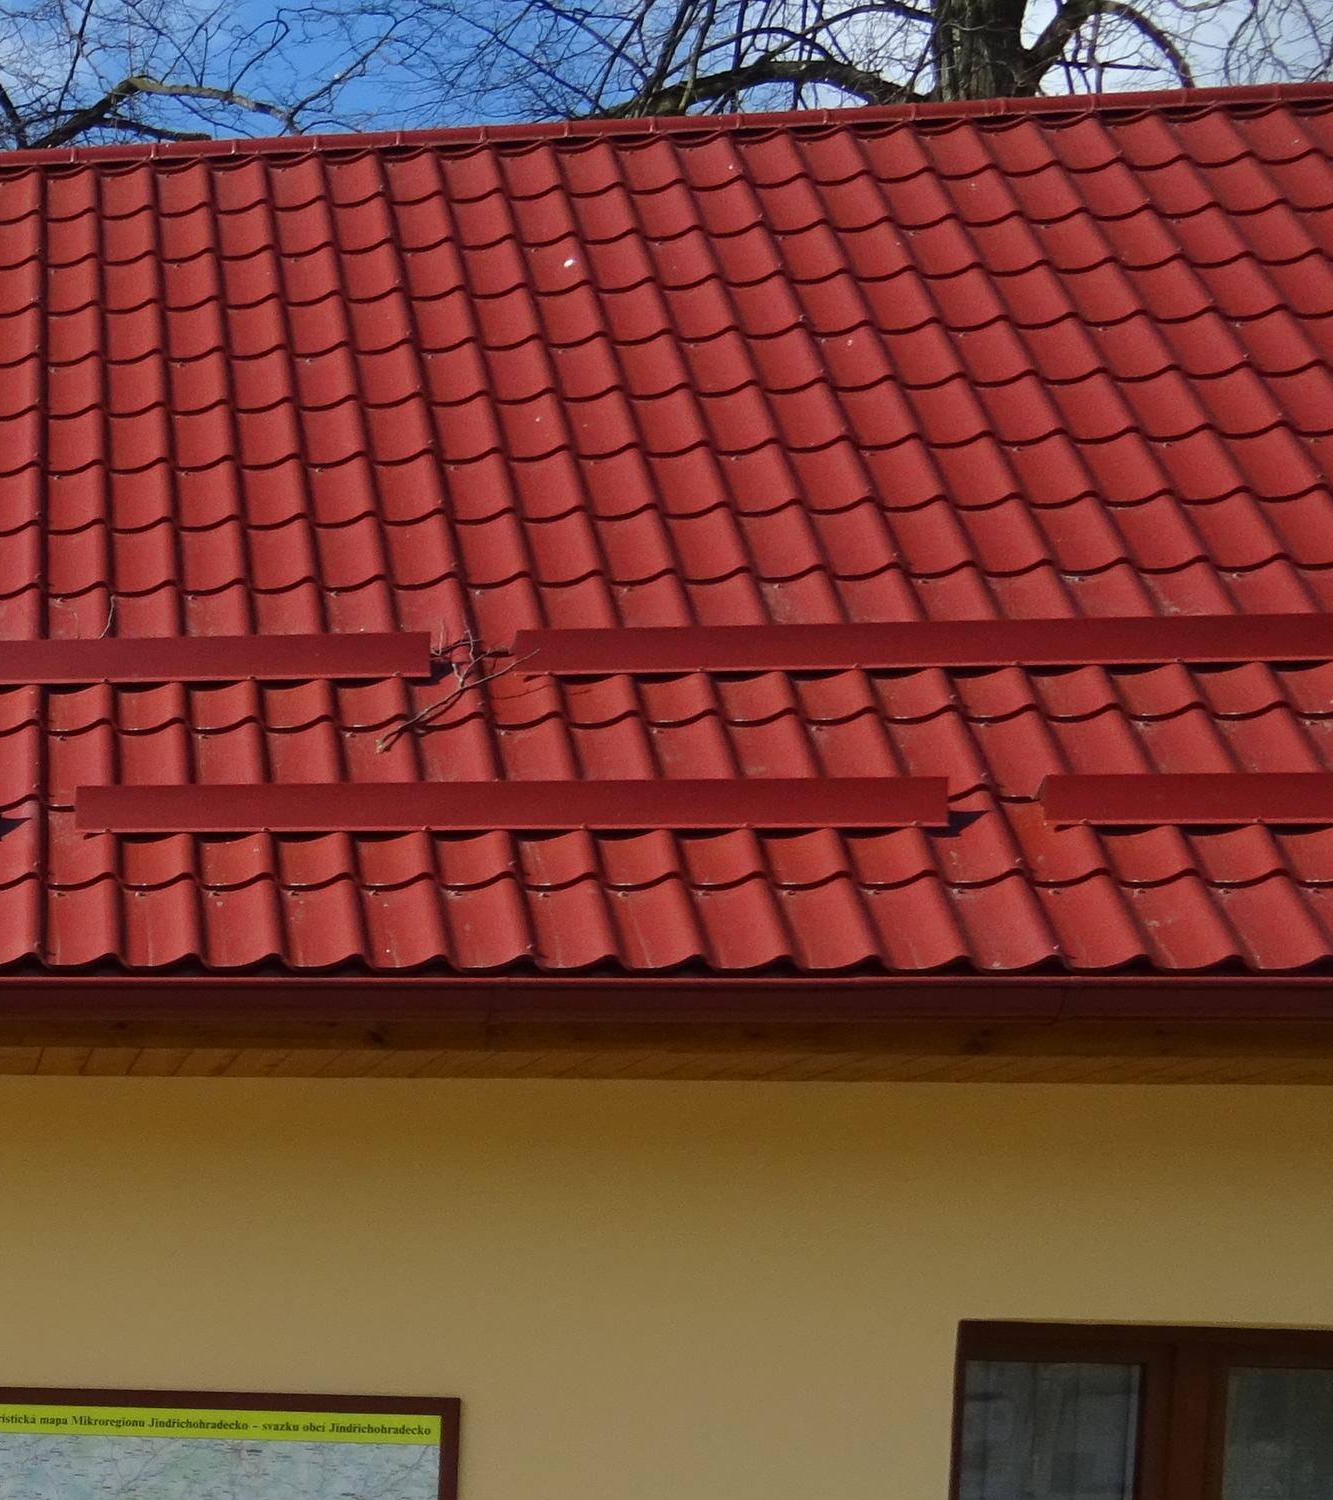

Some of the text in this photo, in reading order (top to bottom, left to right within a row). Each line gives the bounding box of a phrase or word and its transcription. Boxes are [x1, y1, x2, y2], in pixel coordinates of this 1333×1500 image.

[39, 1415, 68, 1427] mapa
[71, 1415, 145, 1429] Mikroregionu
[148, 1417, 249, 1431] Jindřichohradecko
[262, 1421, 299, 1433] svazku
[329, 1422, 432, 1436] Jindřichohradecko
